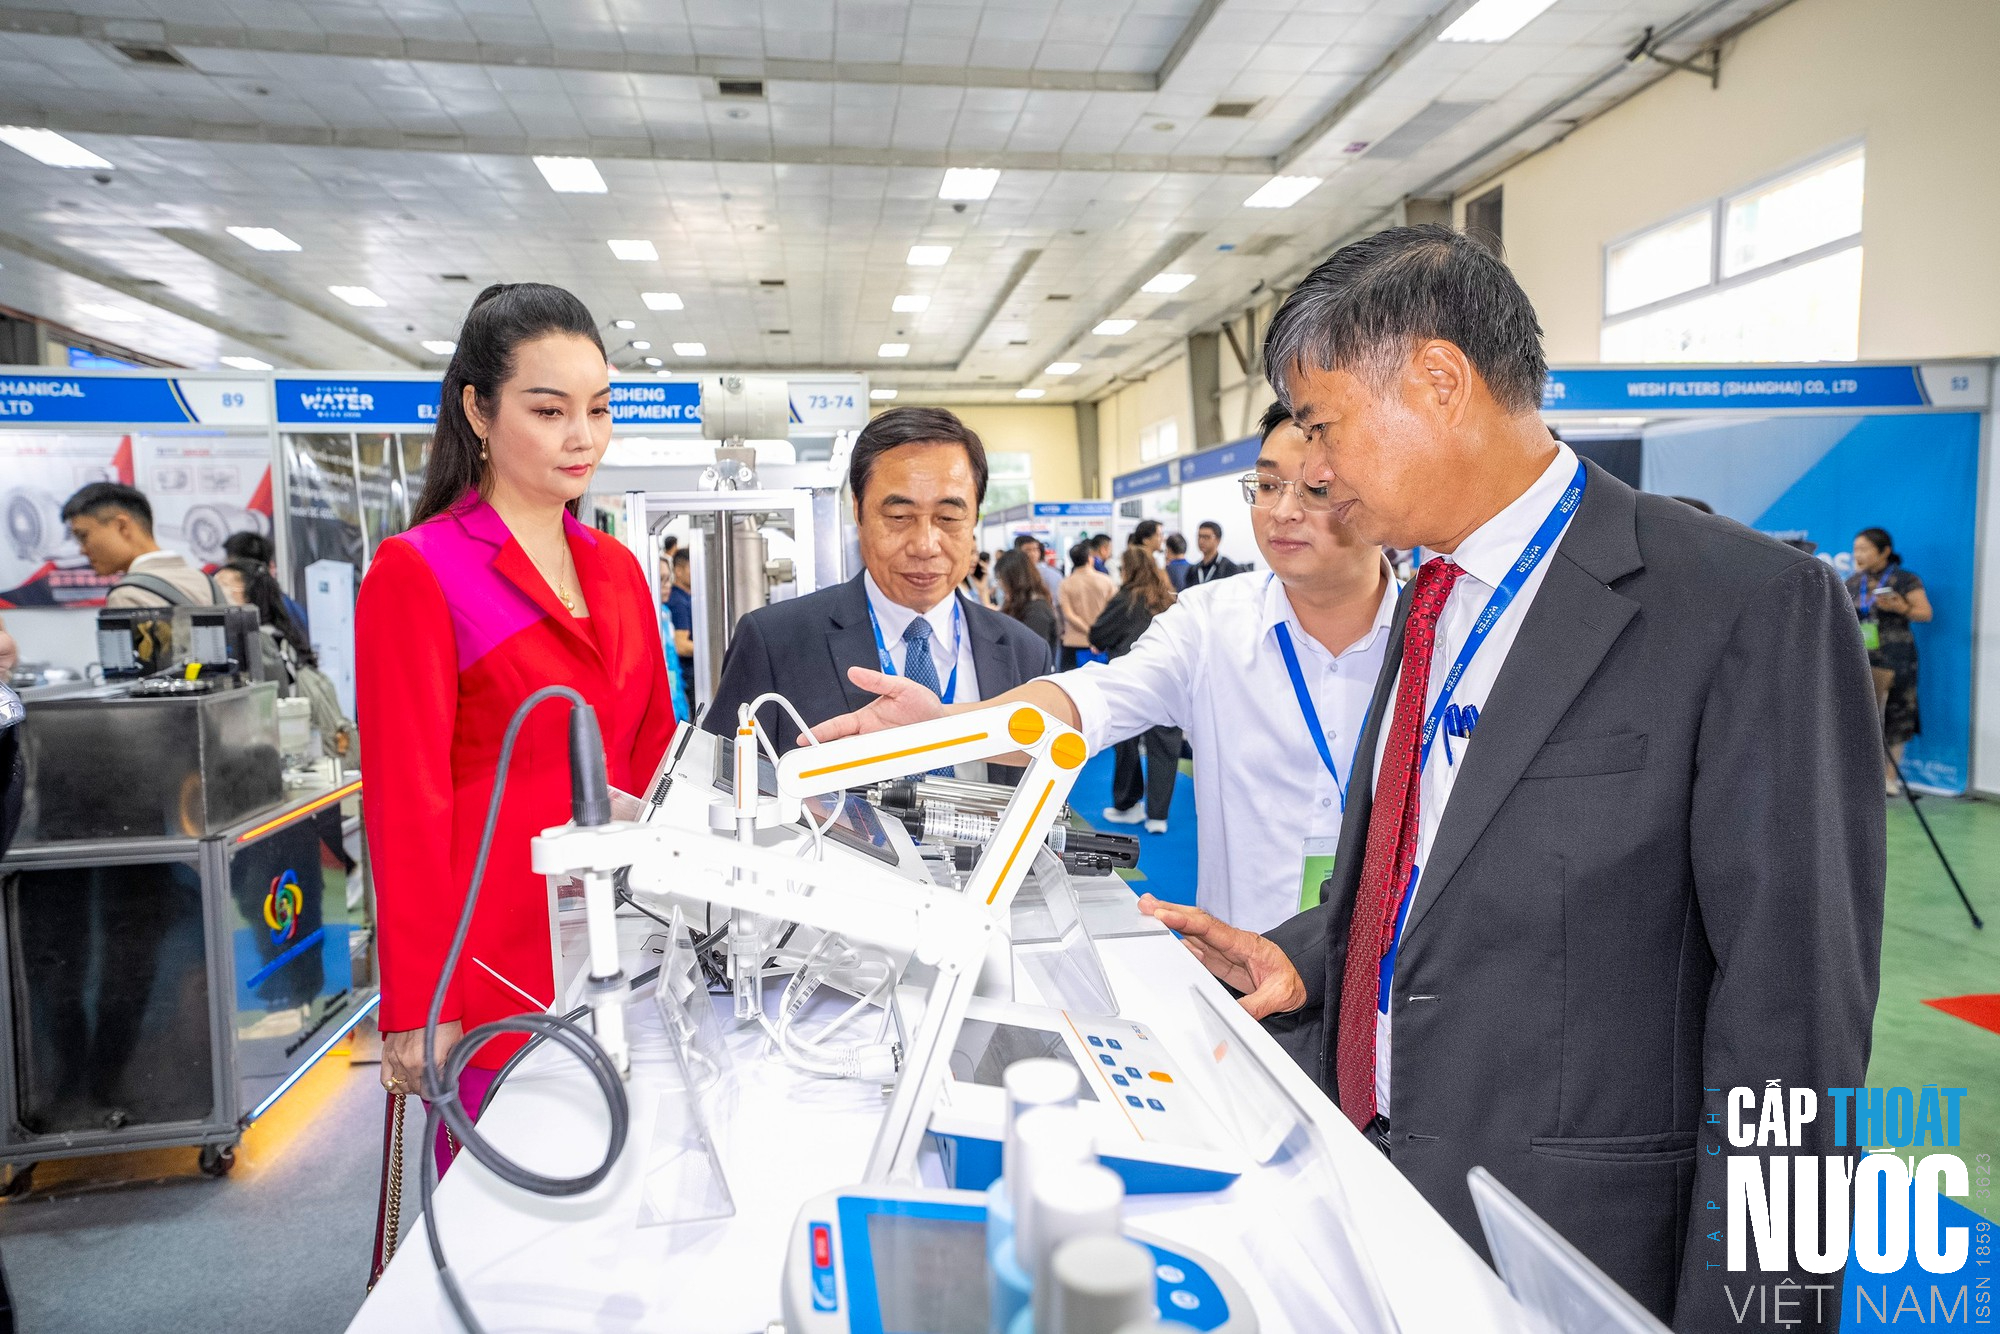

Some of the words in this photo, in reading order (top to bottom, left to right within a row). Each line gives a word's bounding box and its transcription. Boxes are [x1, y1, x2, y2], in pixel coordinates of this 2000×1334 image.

[1668, 381, 1720, 396] FILTERS
[1722, 380, 1802, 397] (SHANGHAI)
[1832, 379, 1858, 393] LTD
[0, 400, 34, 415] LTD
[222, 393, 244, 407] 89
[300, 393, 375, 411] WATER
[808, 395, 854, 409] 73-74
[1560, 487, 1581, 513] WATER
[1516, 545, 1541, 572] WATER
[1476, 605, 1499, 634] WATER
[1445, 663, 1464, 692] WATER
